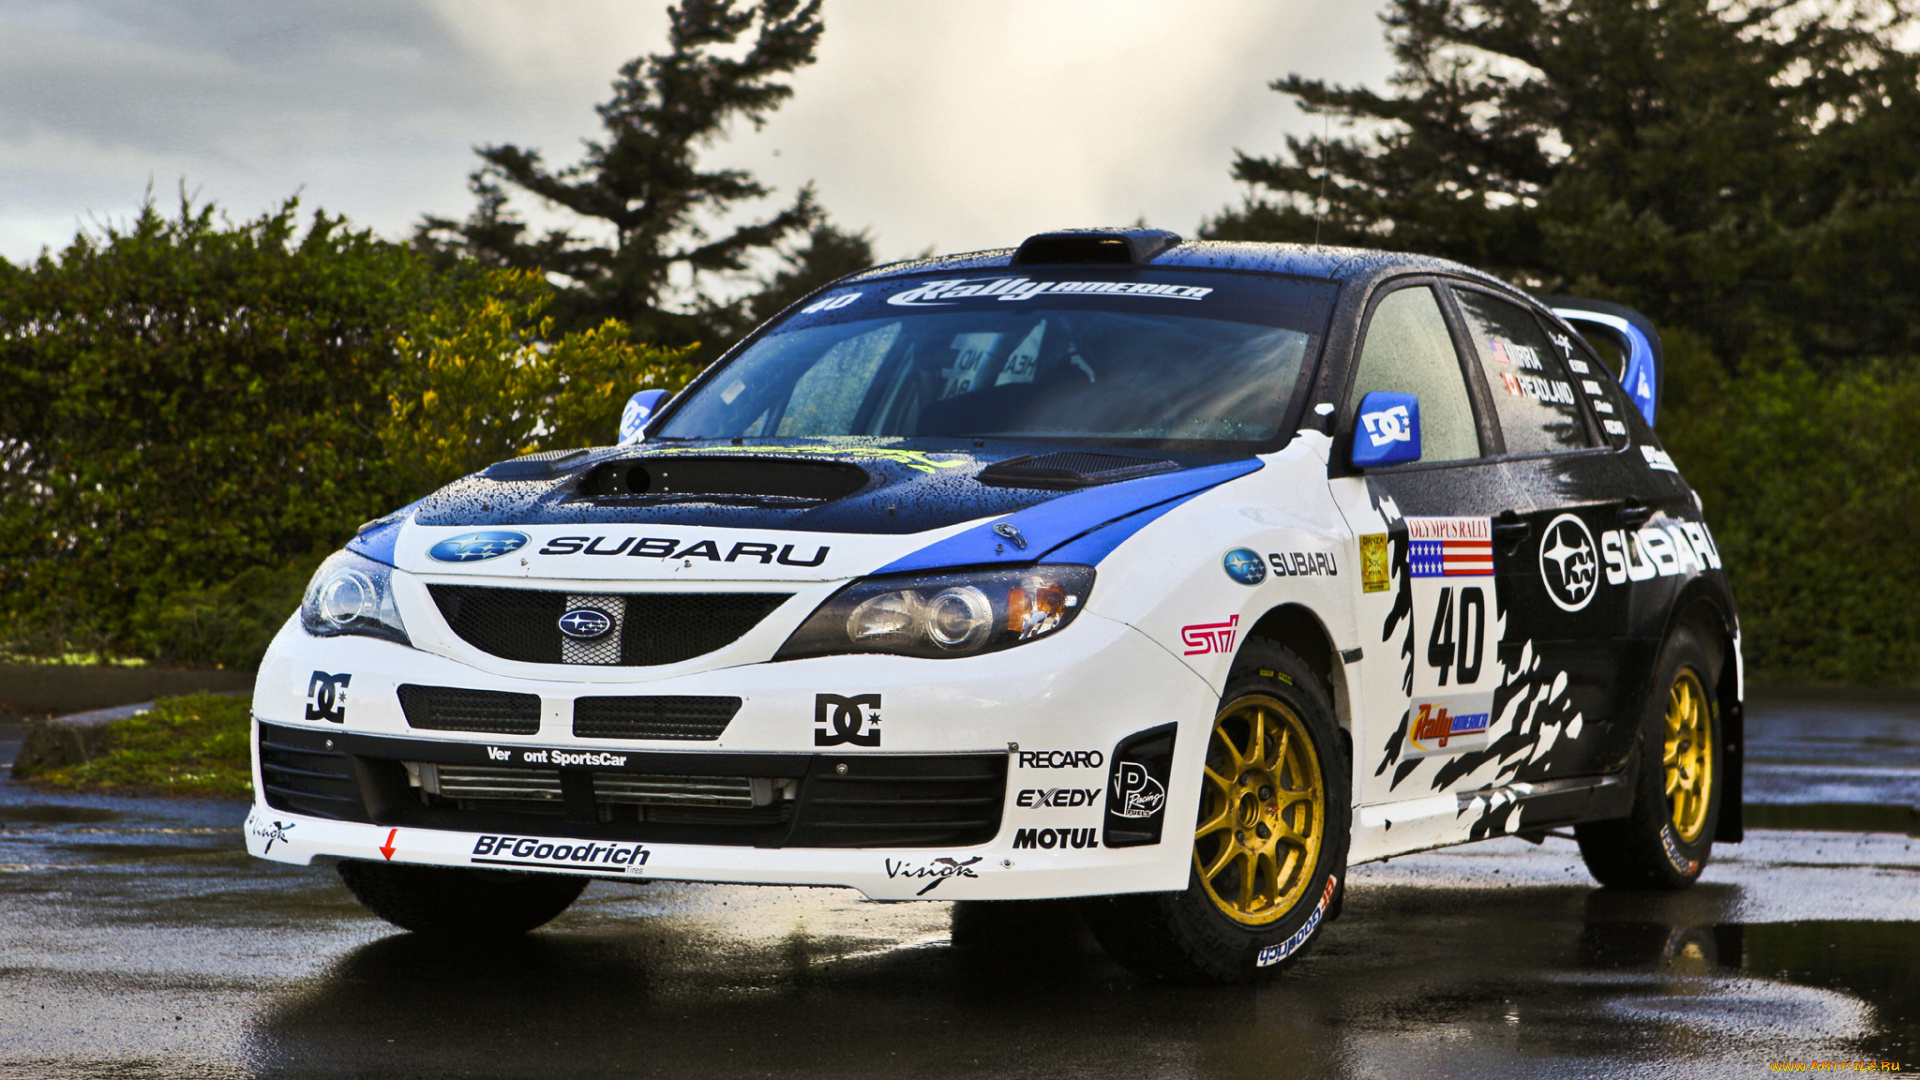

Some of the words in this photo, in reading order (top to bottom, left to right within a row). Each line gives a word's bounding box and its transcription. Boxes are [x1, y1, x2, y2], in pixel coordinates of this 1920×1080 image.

[888, 277, 1055, 305] Rally
[1050, 281, 1213, 298] AMERICA
[801, 292, 863, 314] 40
[1516, 376, 1575, 405] HEADLAND
[1408, 520, 1458, 539] OLYMPUS
[1459, 520, 1489, 539] RALLY
[539, 536, 831, 567] SUBARU
[1601, 521, 1722, 586] SUBARU
[1268, 552, 1338, 577] SUBARU
[1428, 586, 1485, 687] 40
[1413, 704, 1454, 747] Rally
[1450, 713, 1489, 731] AMERICA
[551, 750, 627, 767] SportsCar
[1019, 750, 1104, 768] RECARO
[1016, 788, 1102, 809] EXEDY
[1128, 791, 1165, 810] Racing
[1127, 809, 1151, 817] FUELS
[472, 835, 651, 866] BFGoodrich
[1012, 828, 1100, 850] MOTUL
[625, 865, 644, 875] Tires
[1259, 877, 1337, 966] BFGoodrich
